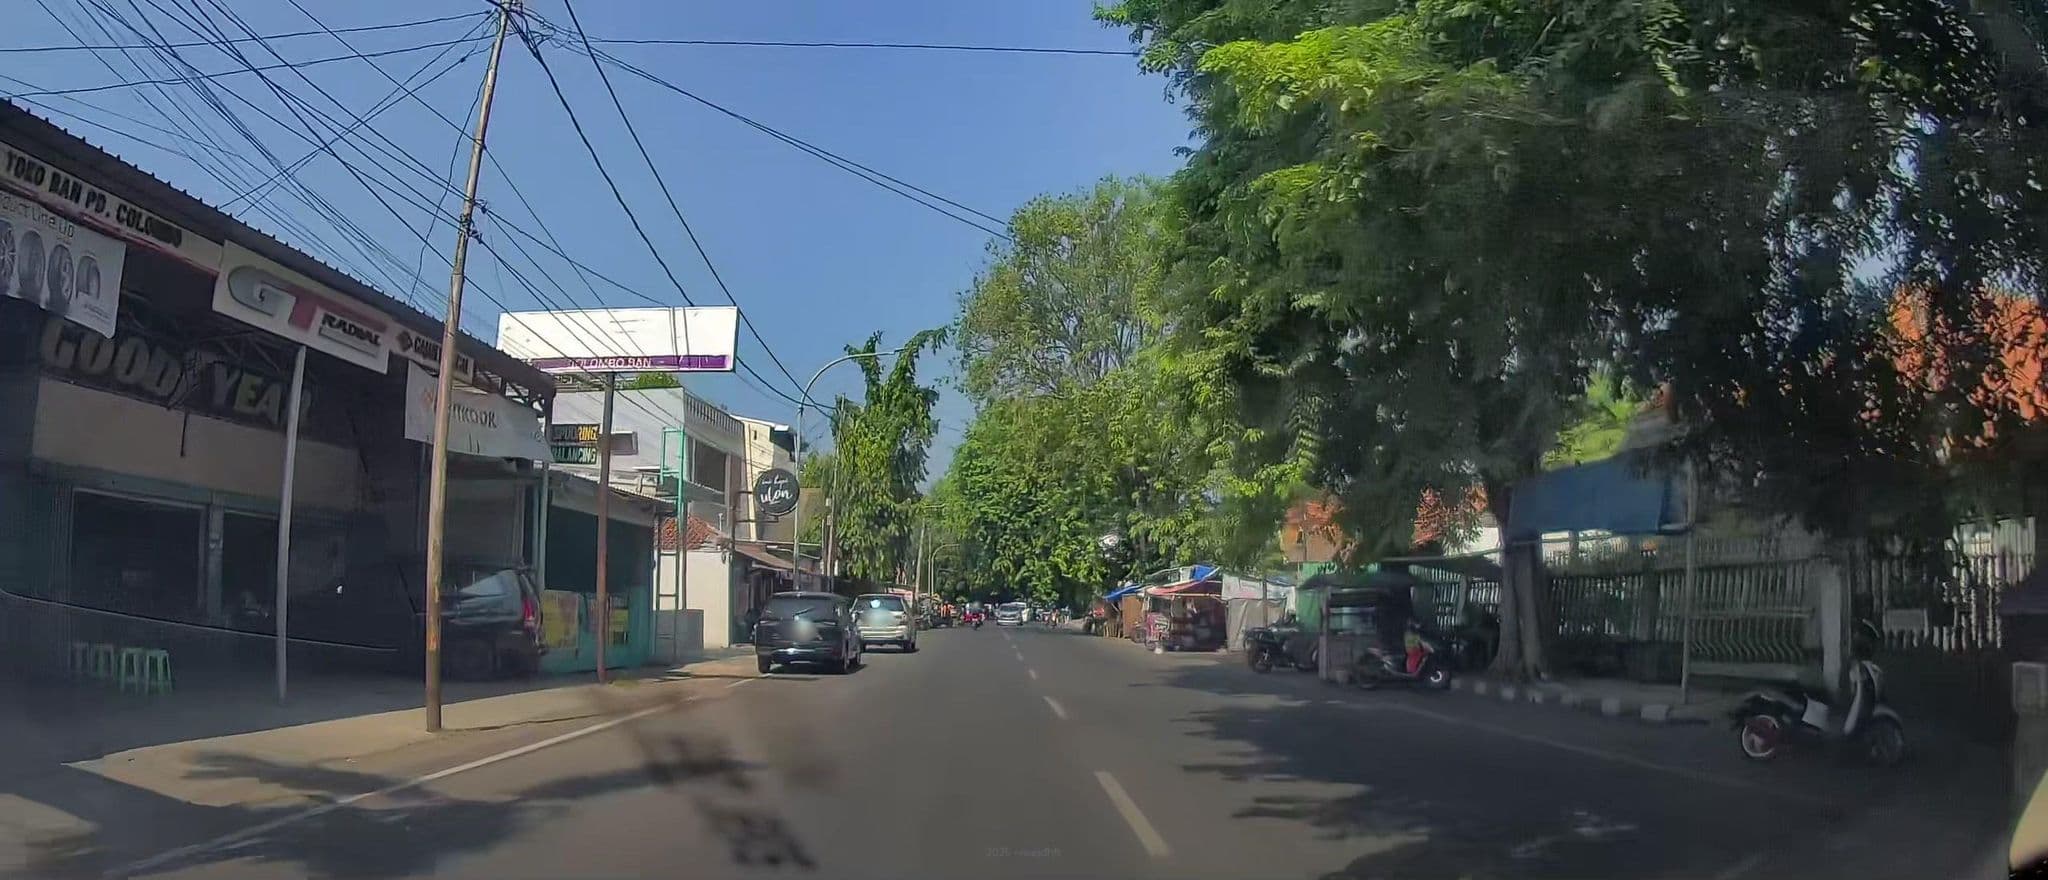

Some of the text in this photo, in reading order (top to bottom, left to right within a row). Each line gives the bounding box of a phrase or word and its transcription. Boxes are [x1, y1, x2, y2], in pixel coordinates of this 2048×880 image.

[48, 171, 82, 204] BAN
[85, 188, 111, 218] PD.
[321, 311, 382, 346] RADIAL
[628, 357, 652, 370] BAN
